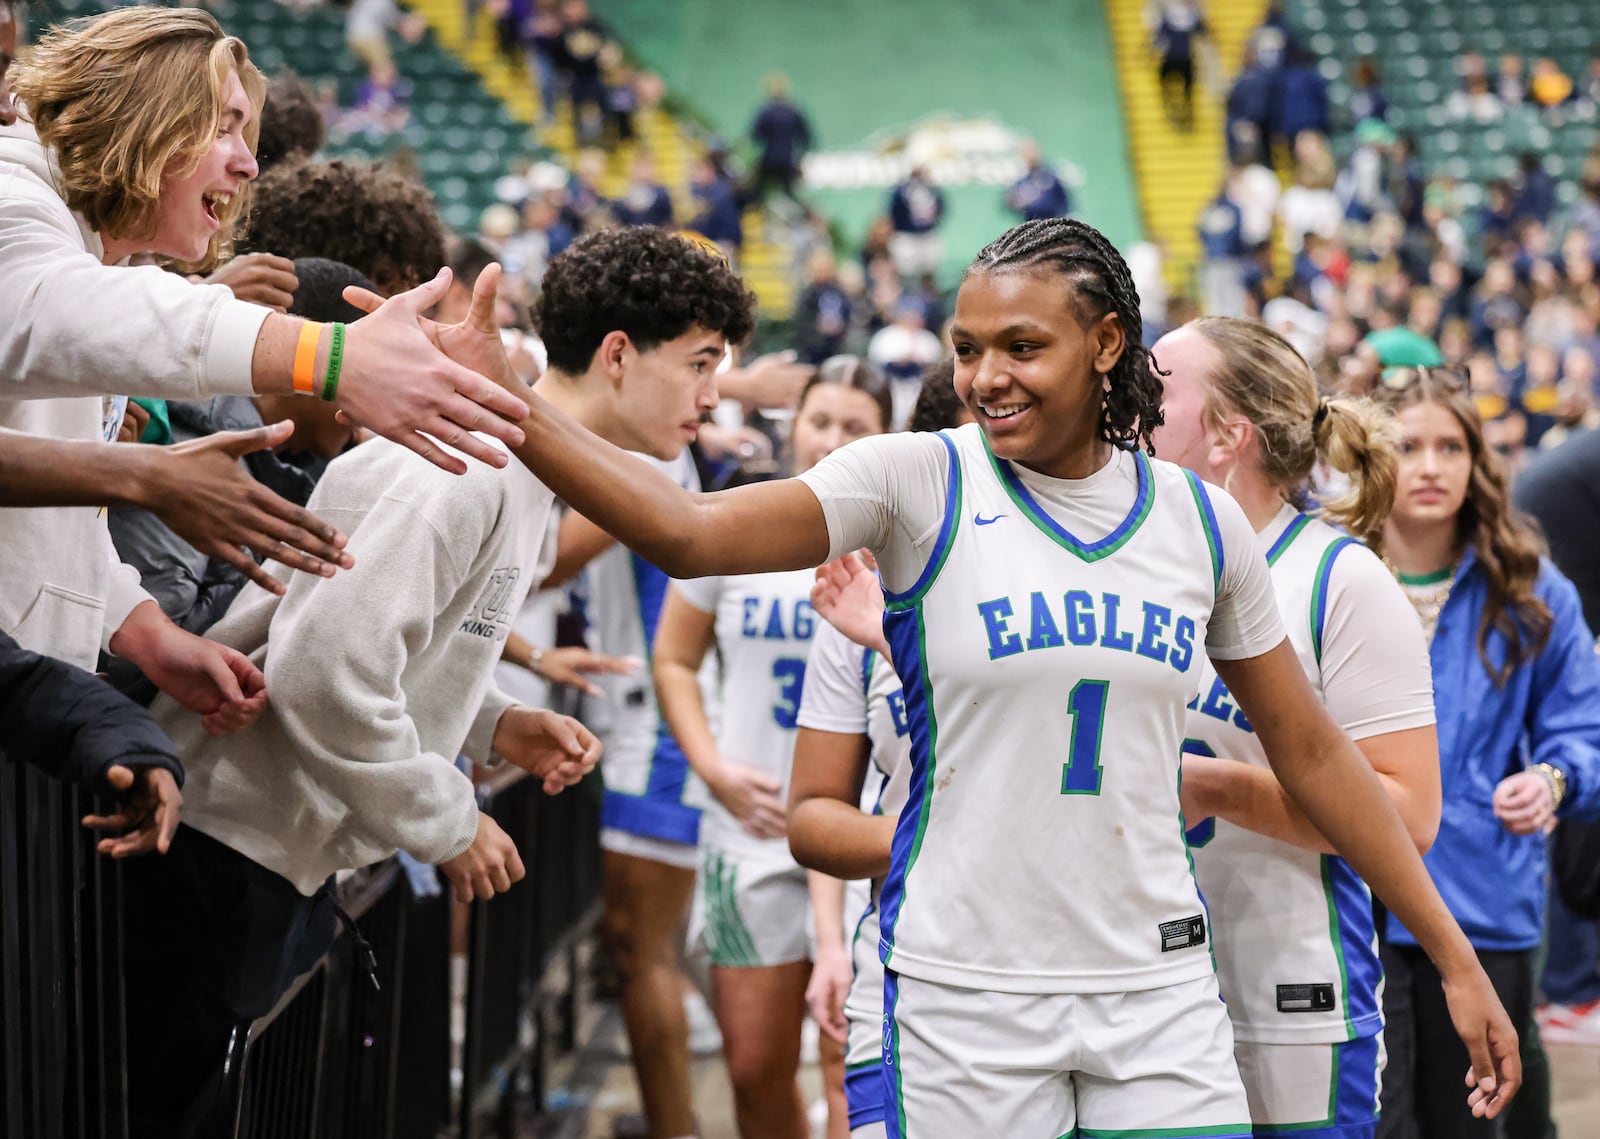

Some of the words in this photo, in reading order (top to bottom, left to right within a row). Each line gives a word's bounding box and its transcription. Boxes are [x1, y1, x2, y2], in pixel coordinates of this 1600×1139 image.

[332, 326, 343, 356] ELIJAH
[328, 359, 339, 380] LIVE
[977, 589, 1195, 673] EAGLES
[1061, 678, 1110, 796] 1
[1192, 923, 1202, 937] M
[1320, 991, 1327, 1003] L
